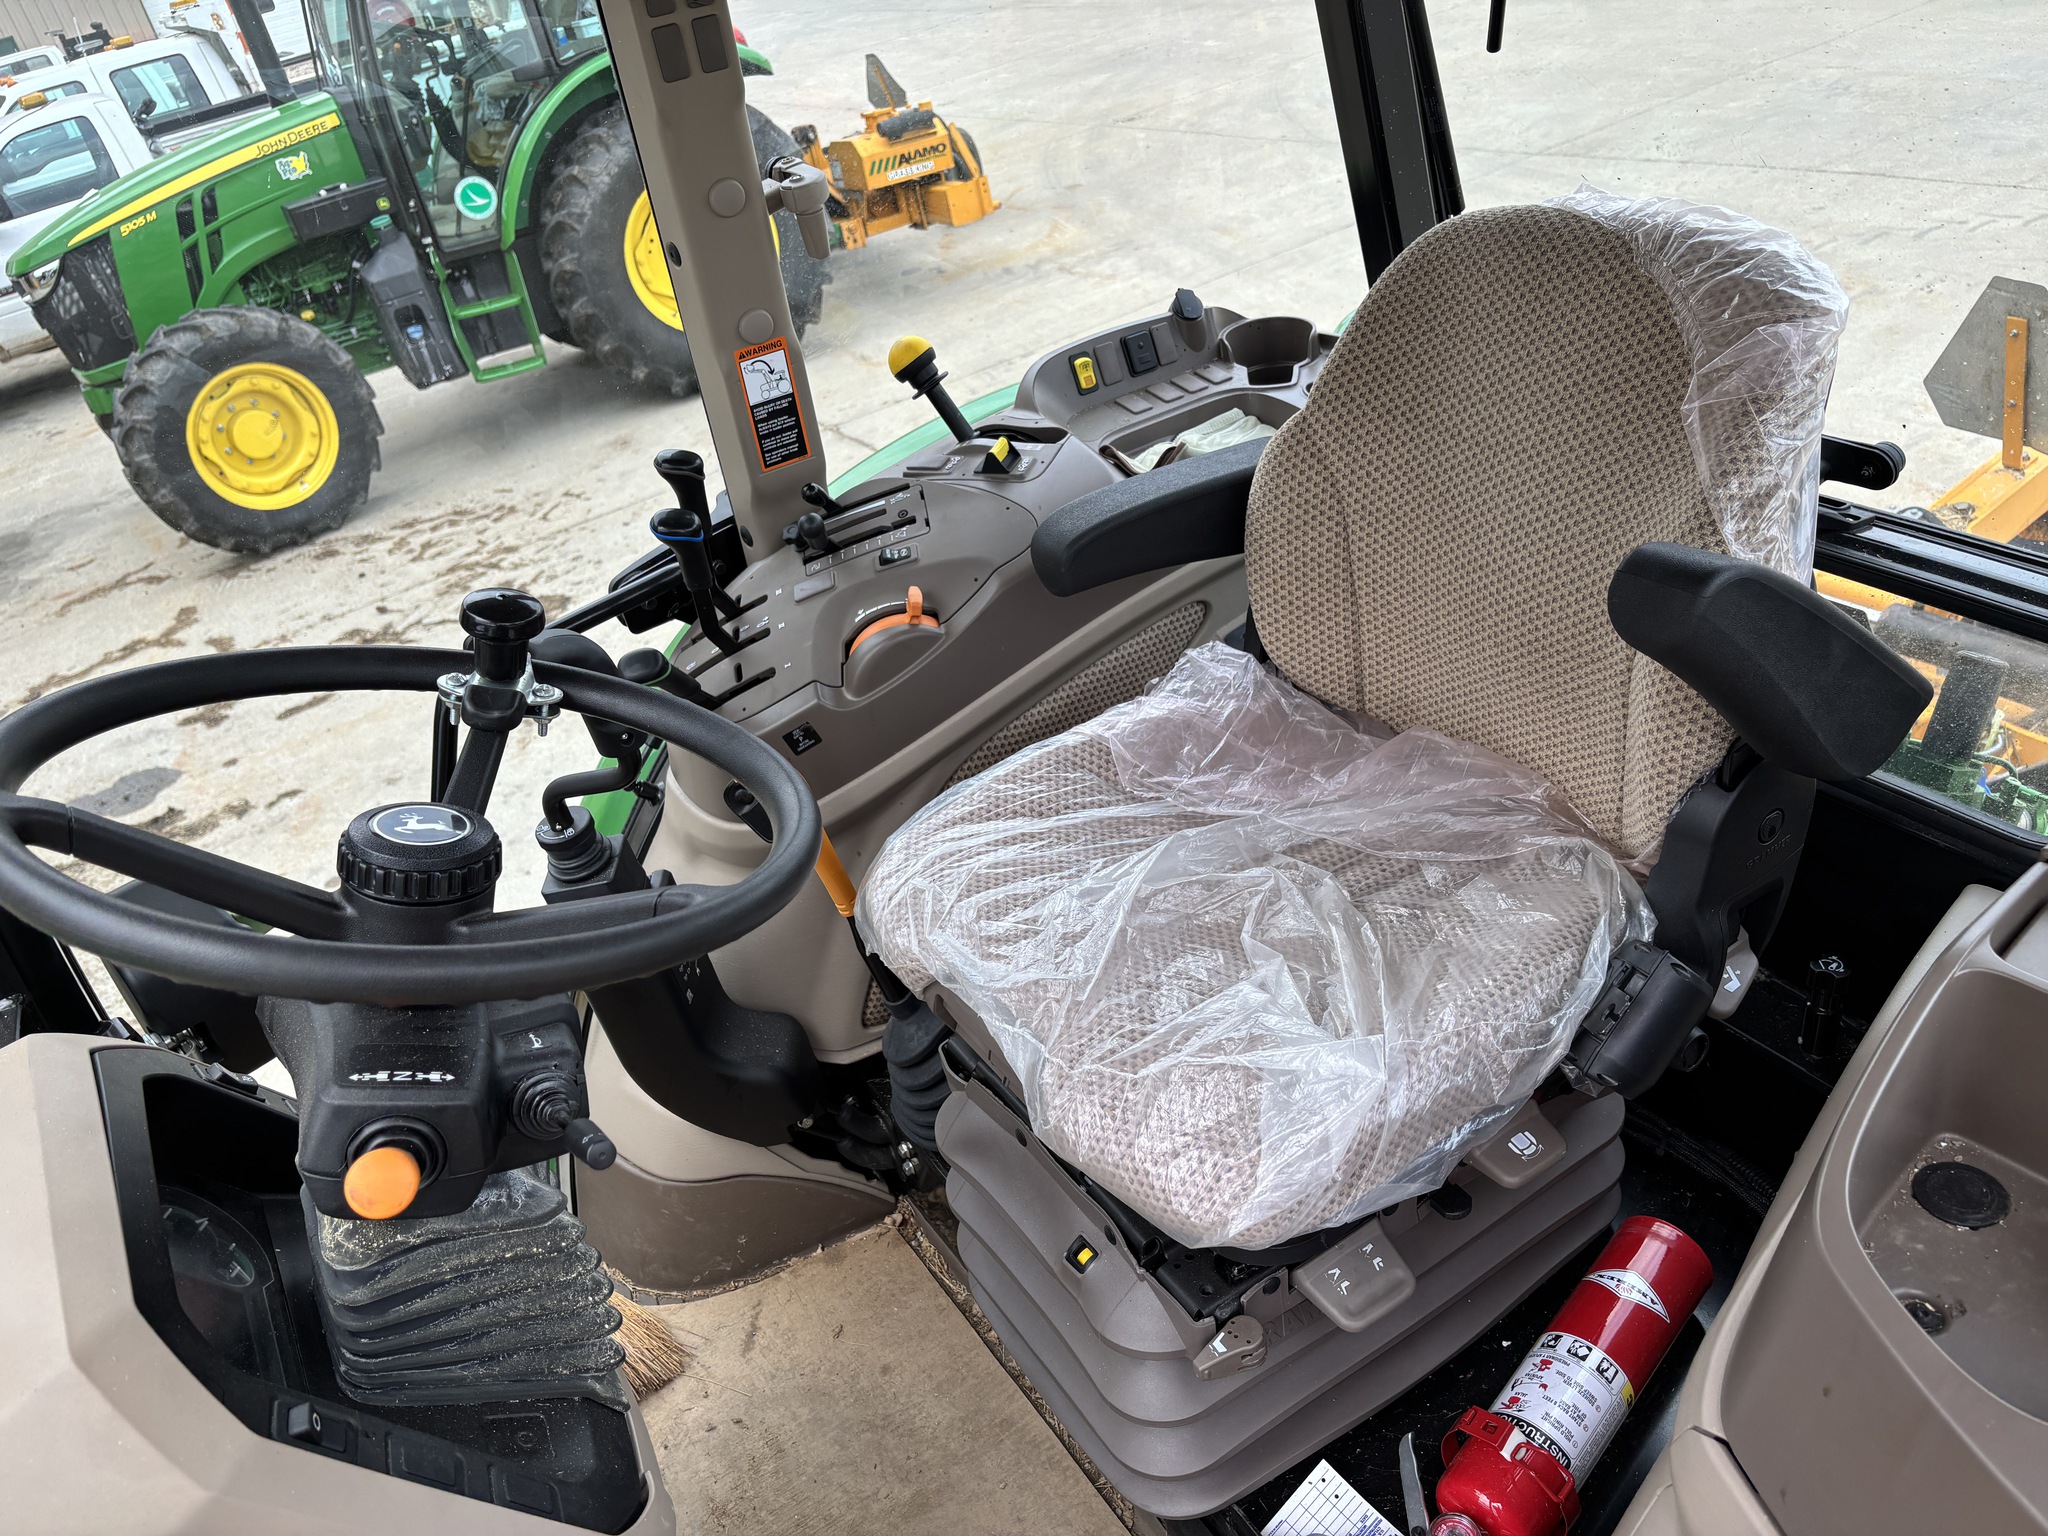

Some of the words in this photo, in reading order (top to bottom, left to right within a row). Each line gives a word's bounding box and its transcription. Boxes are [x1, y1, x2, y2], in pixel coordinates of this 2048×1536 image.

[287, 121, 328, 145] DEERE
[898, 143, 946, 168] ALAMO
[744, 340, 783, 357] WARNING
